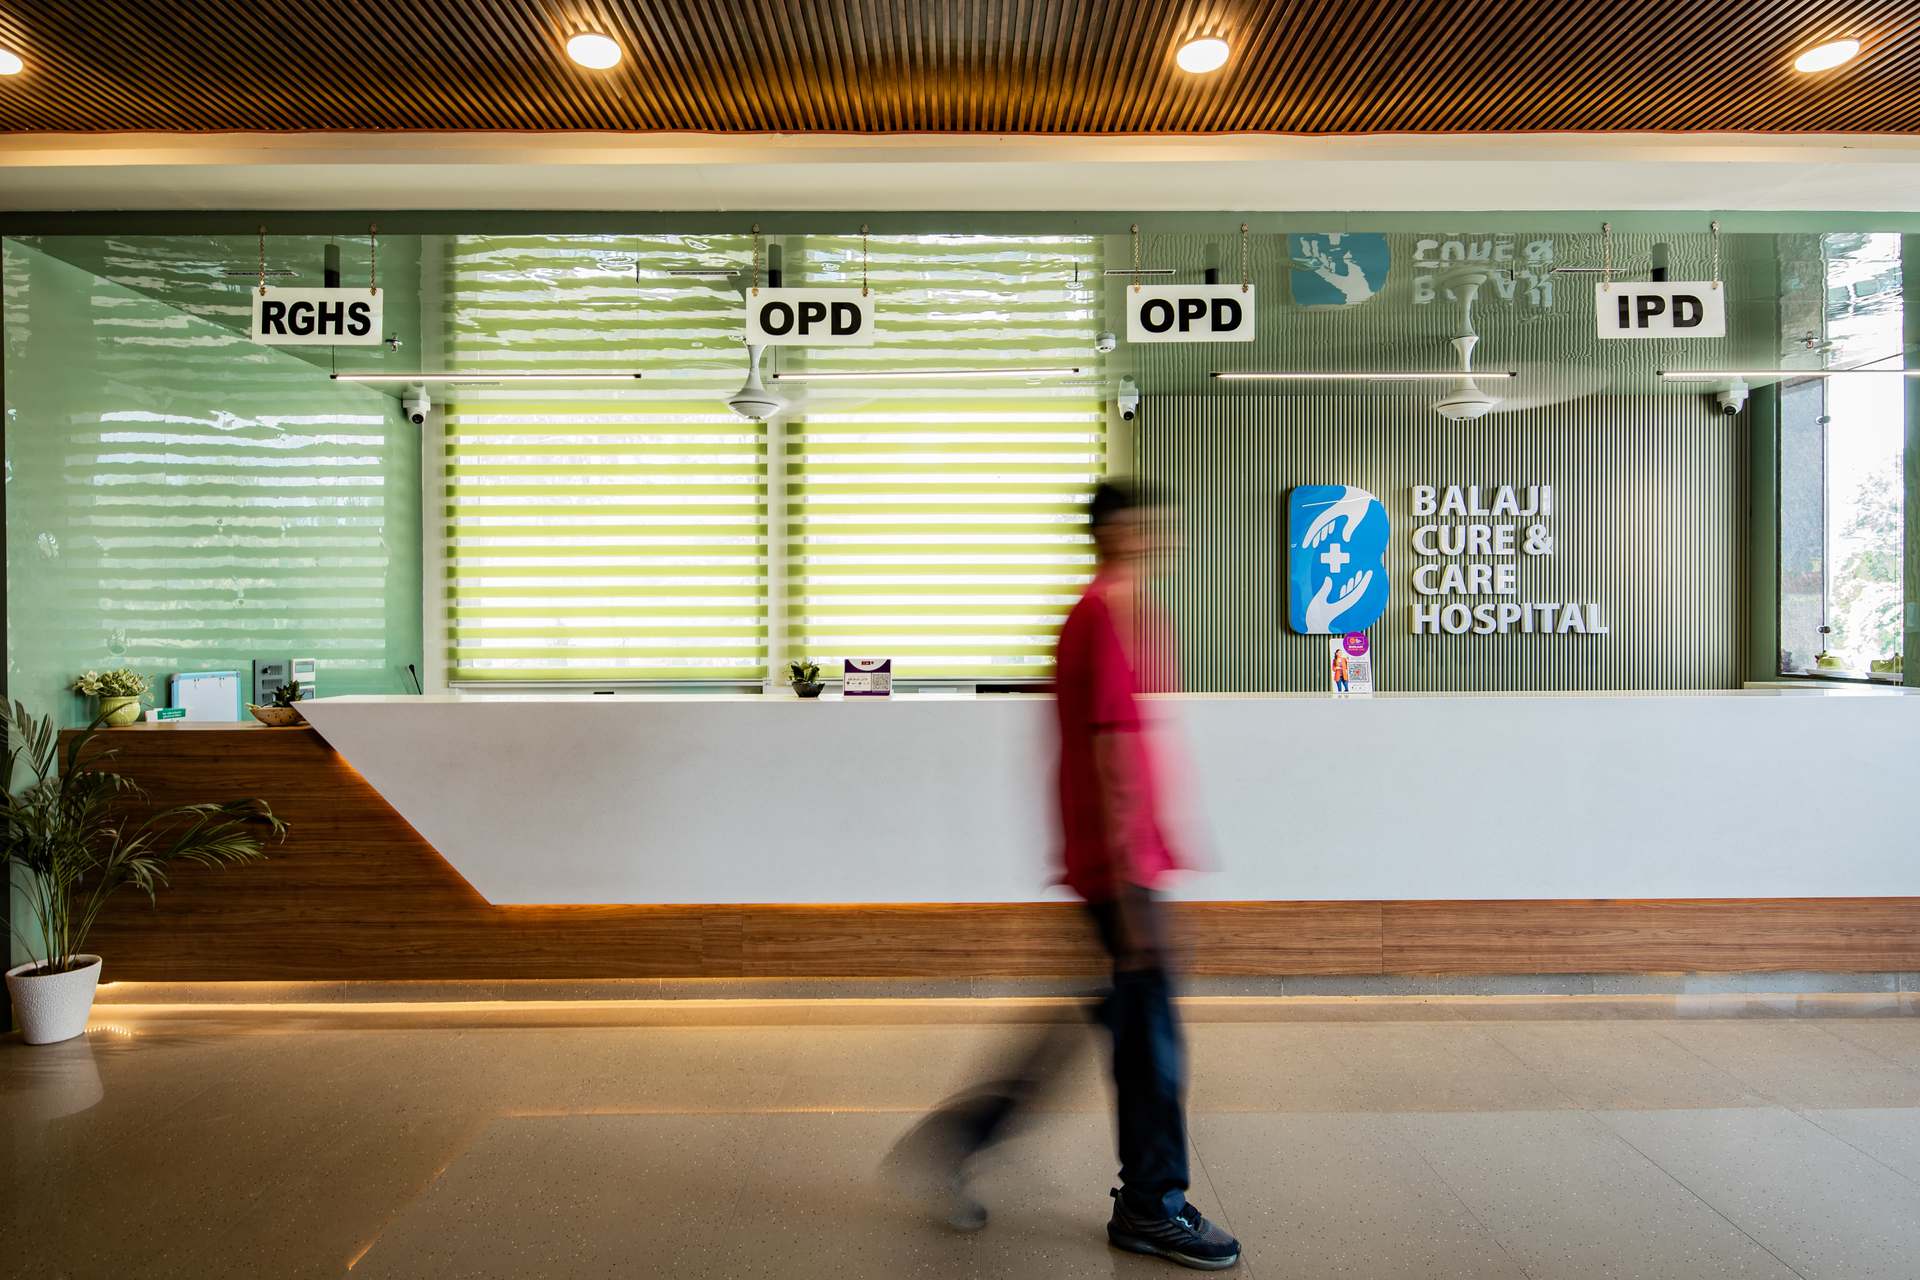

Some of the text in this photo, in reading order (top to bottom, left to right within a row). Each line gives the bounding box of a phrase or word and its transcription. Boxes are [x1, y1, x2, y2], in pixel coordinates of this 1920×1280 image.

[261, 301, 371, 336] RGHS
[759, 301, 862, 336] OPD
[1140, 298, 1243, 333] OPD
[1618, 294, 1704, 329] IPD
[1411, 485, 1552, 517] BALAJI
[1411, 523, 1554, 556] CURE &
[1411, 563, 1517, 595] CARE
[1411, 602, 1609, 635] HOSPITAL
